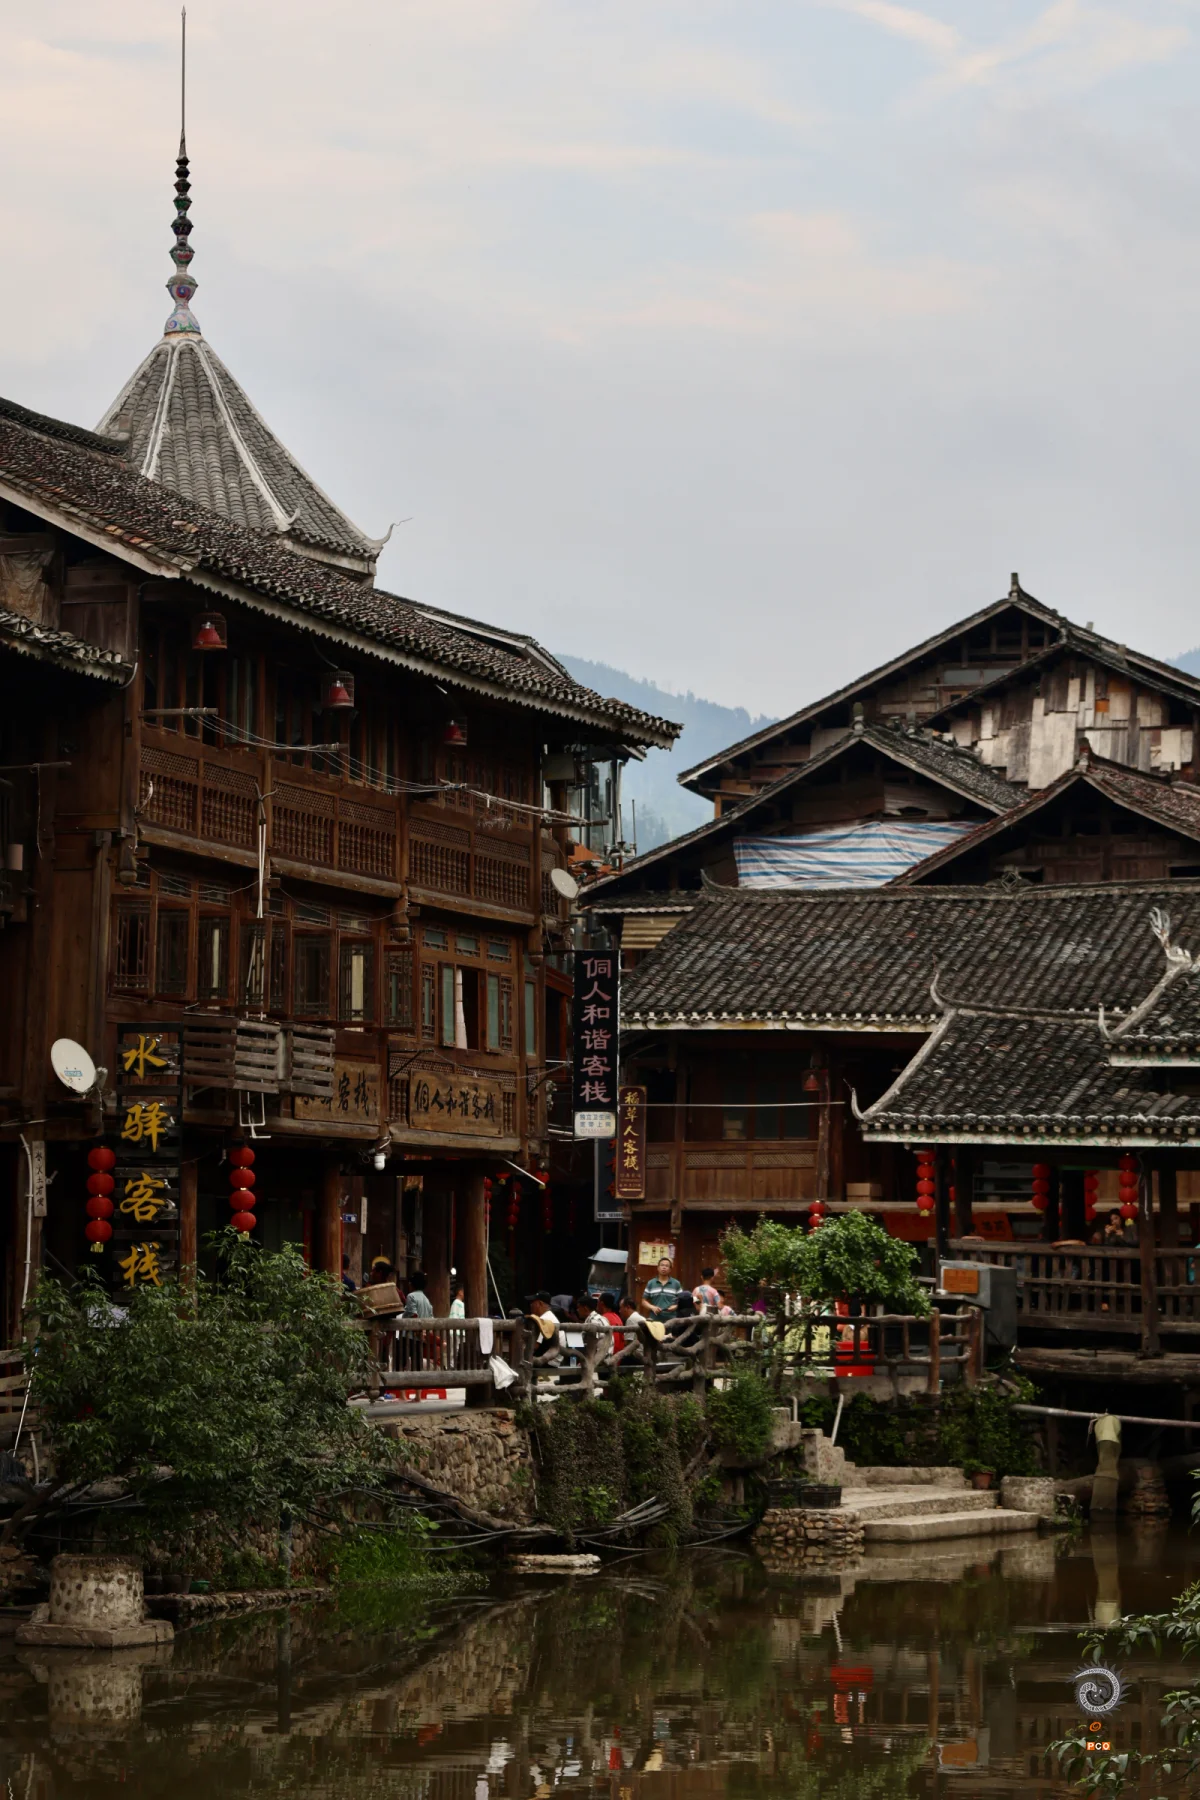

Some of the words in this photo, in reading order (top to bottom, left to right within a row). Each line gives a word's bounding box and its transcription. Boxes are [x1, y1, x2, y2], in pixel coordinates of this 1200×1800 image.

[580, 957, 612, 1103] 侗人和谐客栈
[119, 1034, 168, 1287] 水驿客栈
